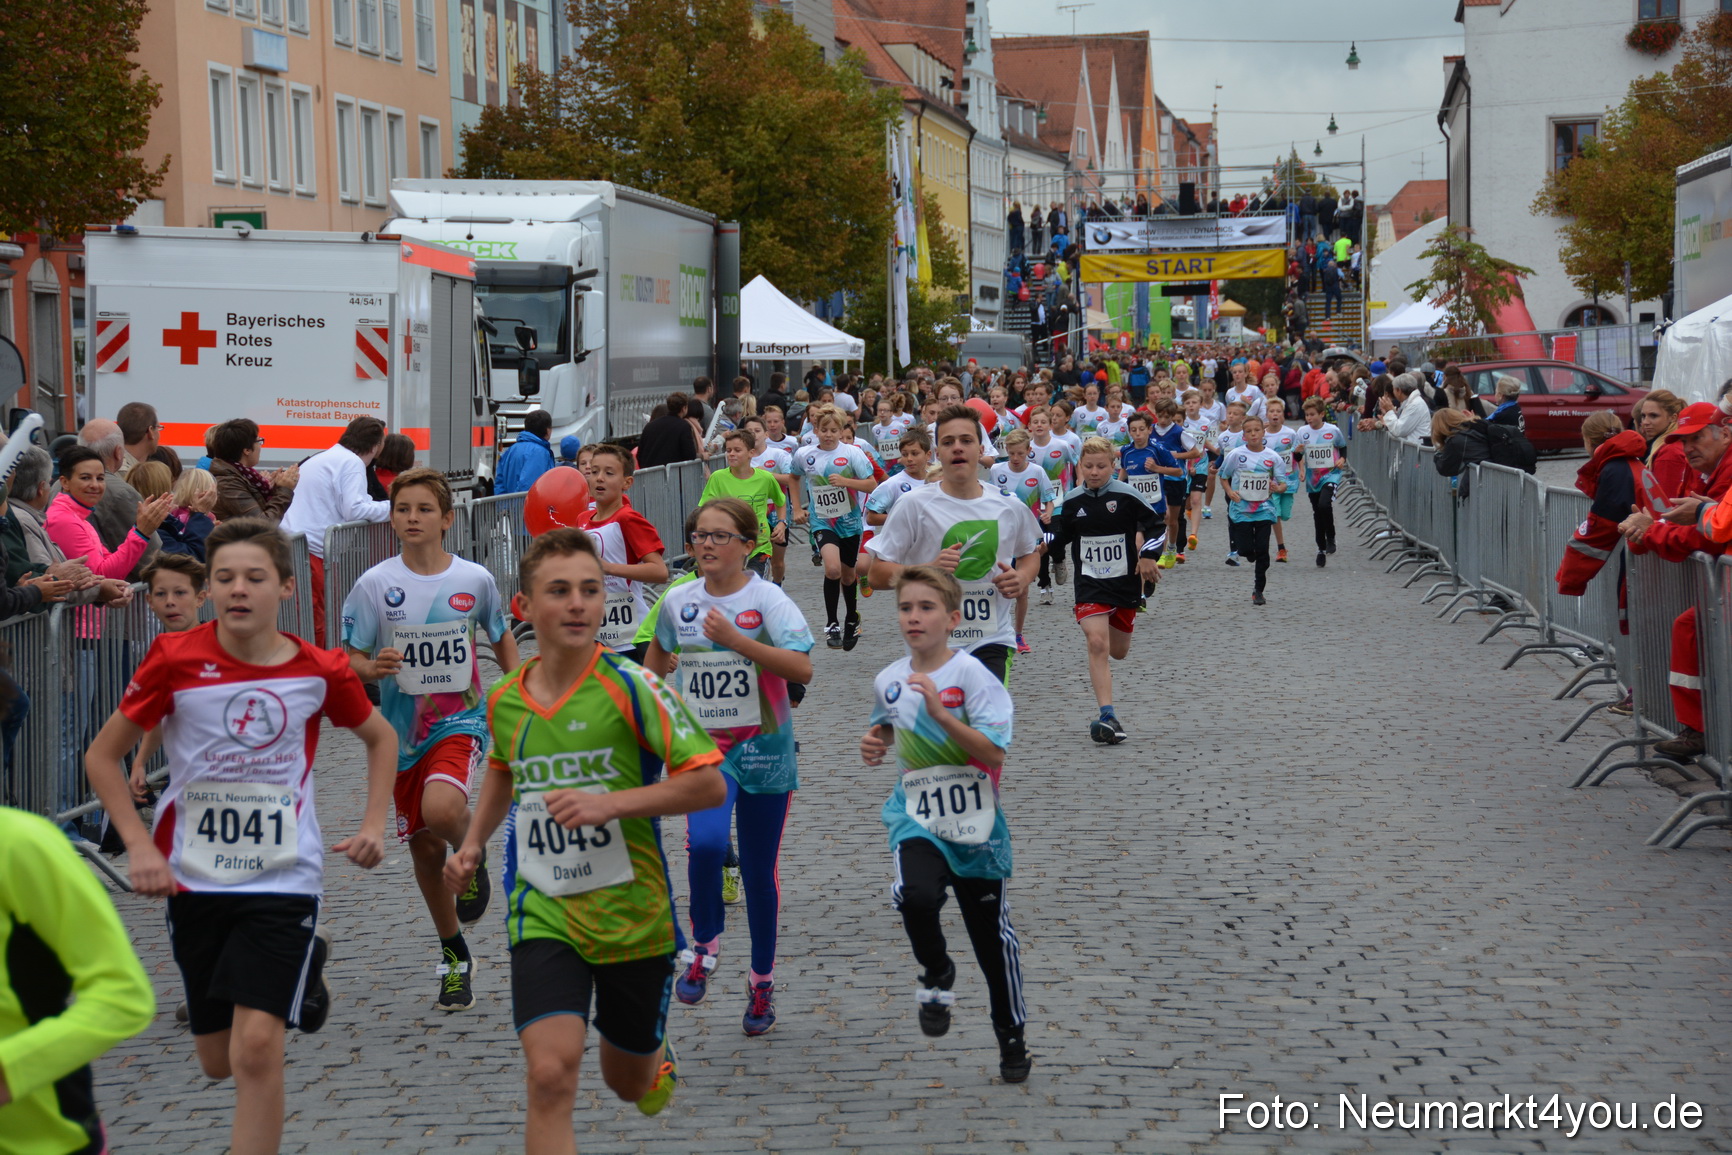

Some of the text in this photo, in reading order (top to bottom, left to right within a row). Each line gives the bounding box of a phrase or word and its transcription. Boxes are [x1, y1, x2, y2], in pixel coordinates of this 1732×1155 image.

[430, 240, 518, 260] OCK
[1146, 257, 1217, 276] START
[349, 297, 383, 306] 44/54/1
[680, 267, 706, 324] BOCK
[226, 312, 326, 330] Bayerisches
[226, 333, 273, 347] Rotes
[1151, 337, 1158, 346] A
[746, 342, 811, 356] Laufsport
[226, 353, 273, 367] Kreuz
[276, 397, 381, 410] Katastrophenschutz
[286, 409, 332, 420] Freistaat
[881, 442, 899, 452] 4044
[1309, 449, 1331, 459] 4000
[1242, 479, 1268, 491] 4102
[817, 490, 846, 507] 4030
[1085, 545, 1122, 562] 4100
[1090, 564, 1112, 574] FELIX
[395, 628, 460, 639] PARTL Neumarkt
[402, 637, 467, 668] 4045
[681, 658, 741, 668] PARTL Neumarkt
[420, 673, 452, 685] Jonas
[689, 669, 750, 700] 4023
[699, 706, 739, 719] Luciana
[741, 741, 759, 755] 16.
[741, 754, 780, 763] Neumarkter
[904, 772, 974, 790] PARTL Neumarkt
[187, 792, 277, 805] PARTL Neumarkt
[916, 781, 982, 820] 4101
[519, 802, 545, 813] ARTL
[197, 807, 283, 846] 4041
[528, 816, 613, 856] 4043
[214, 854, 264, 871] Patrick
[553, 861, 593, 881] David
